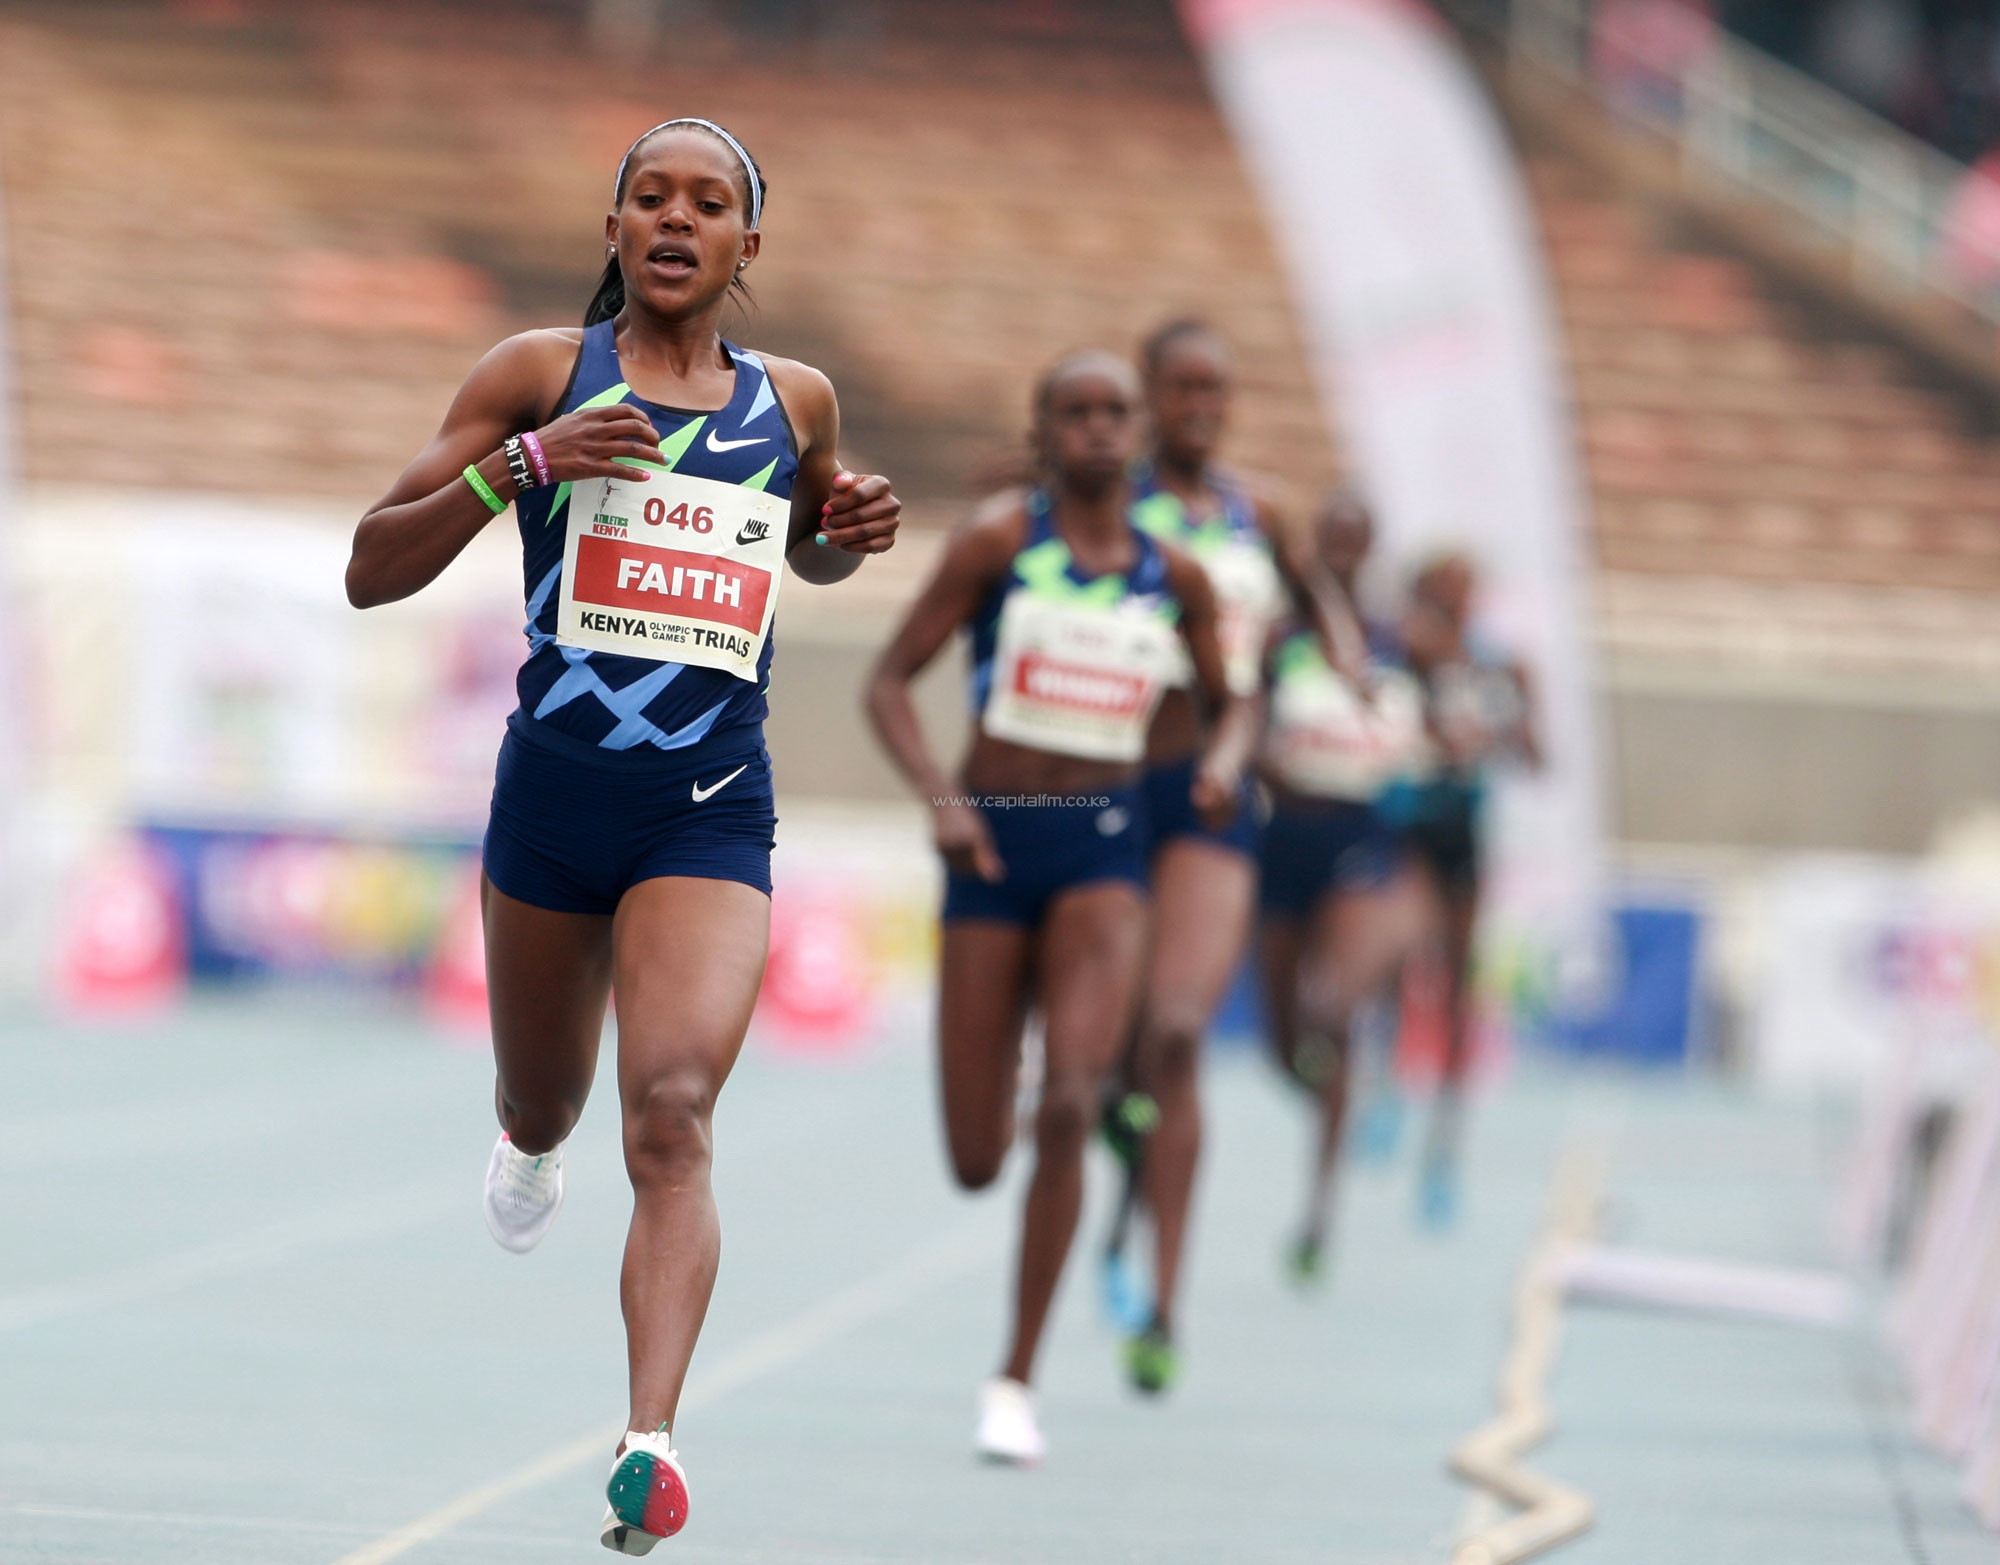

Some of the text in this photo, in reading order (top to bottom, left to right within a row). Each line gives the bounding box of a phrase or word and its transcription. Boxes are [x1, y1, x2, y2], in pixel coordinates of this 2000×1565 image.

[593, 513, 629, 527] ATHLETICS
[643, 497, 714, 534] 046
[743, 518, 770, 537] NIKE
[592, 524, 628, 538] KENYA
[617, 557, 741, 608] FAITH
[580, 611, 751, 658] KENYA OLYMPIC GAMES TRIALS
